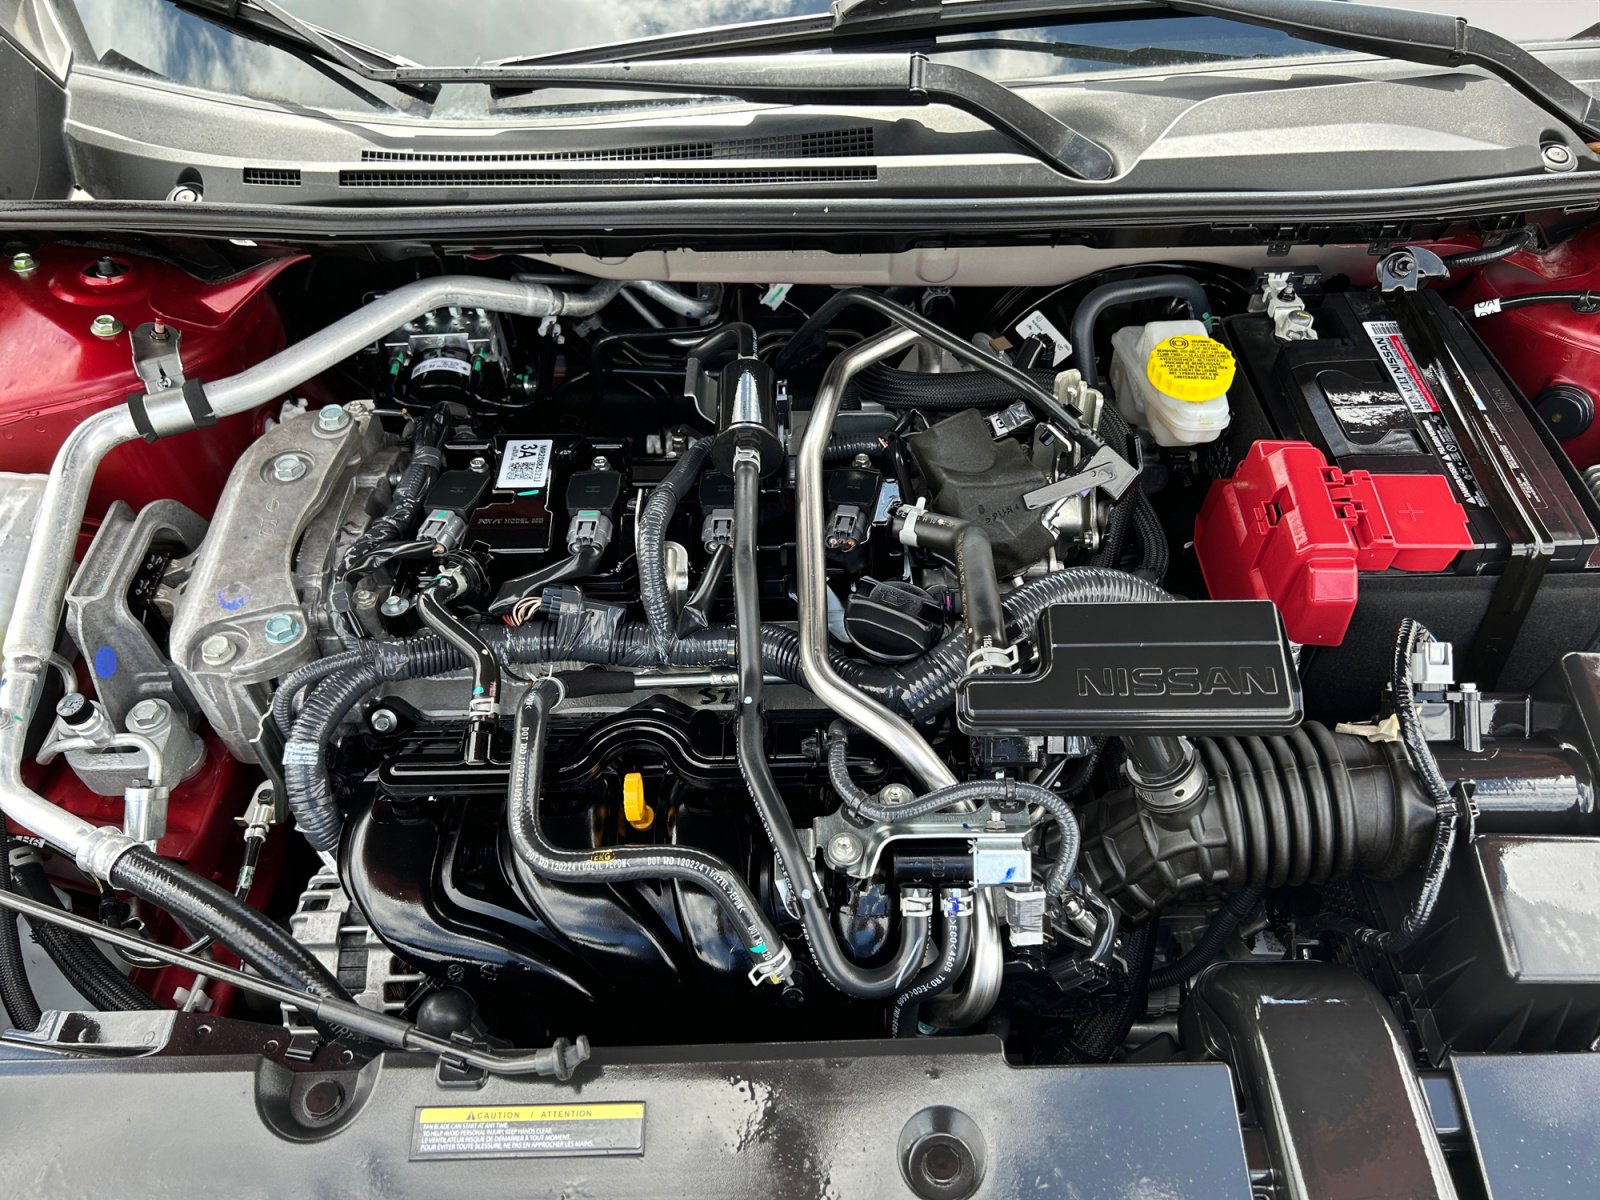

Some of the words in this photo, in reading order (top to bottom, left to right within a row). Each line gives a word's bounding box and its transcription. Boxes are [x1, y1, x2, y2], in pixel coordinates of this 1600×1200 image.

[1375, 337, 1402, 374] NISSAN
[518, 444, 538, 459] 3A
[1076, 666, 1279, 697] NISSAN
[520, 726, 529, 744] DOT
[647, 857, 661, 865] DOT
[677, 857, 704, 871] 120224
[477, 1111, 520, 1120] CAUTION
[541, 1110, 592, 1118] ATTENTION
